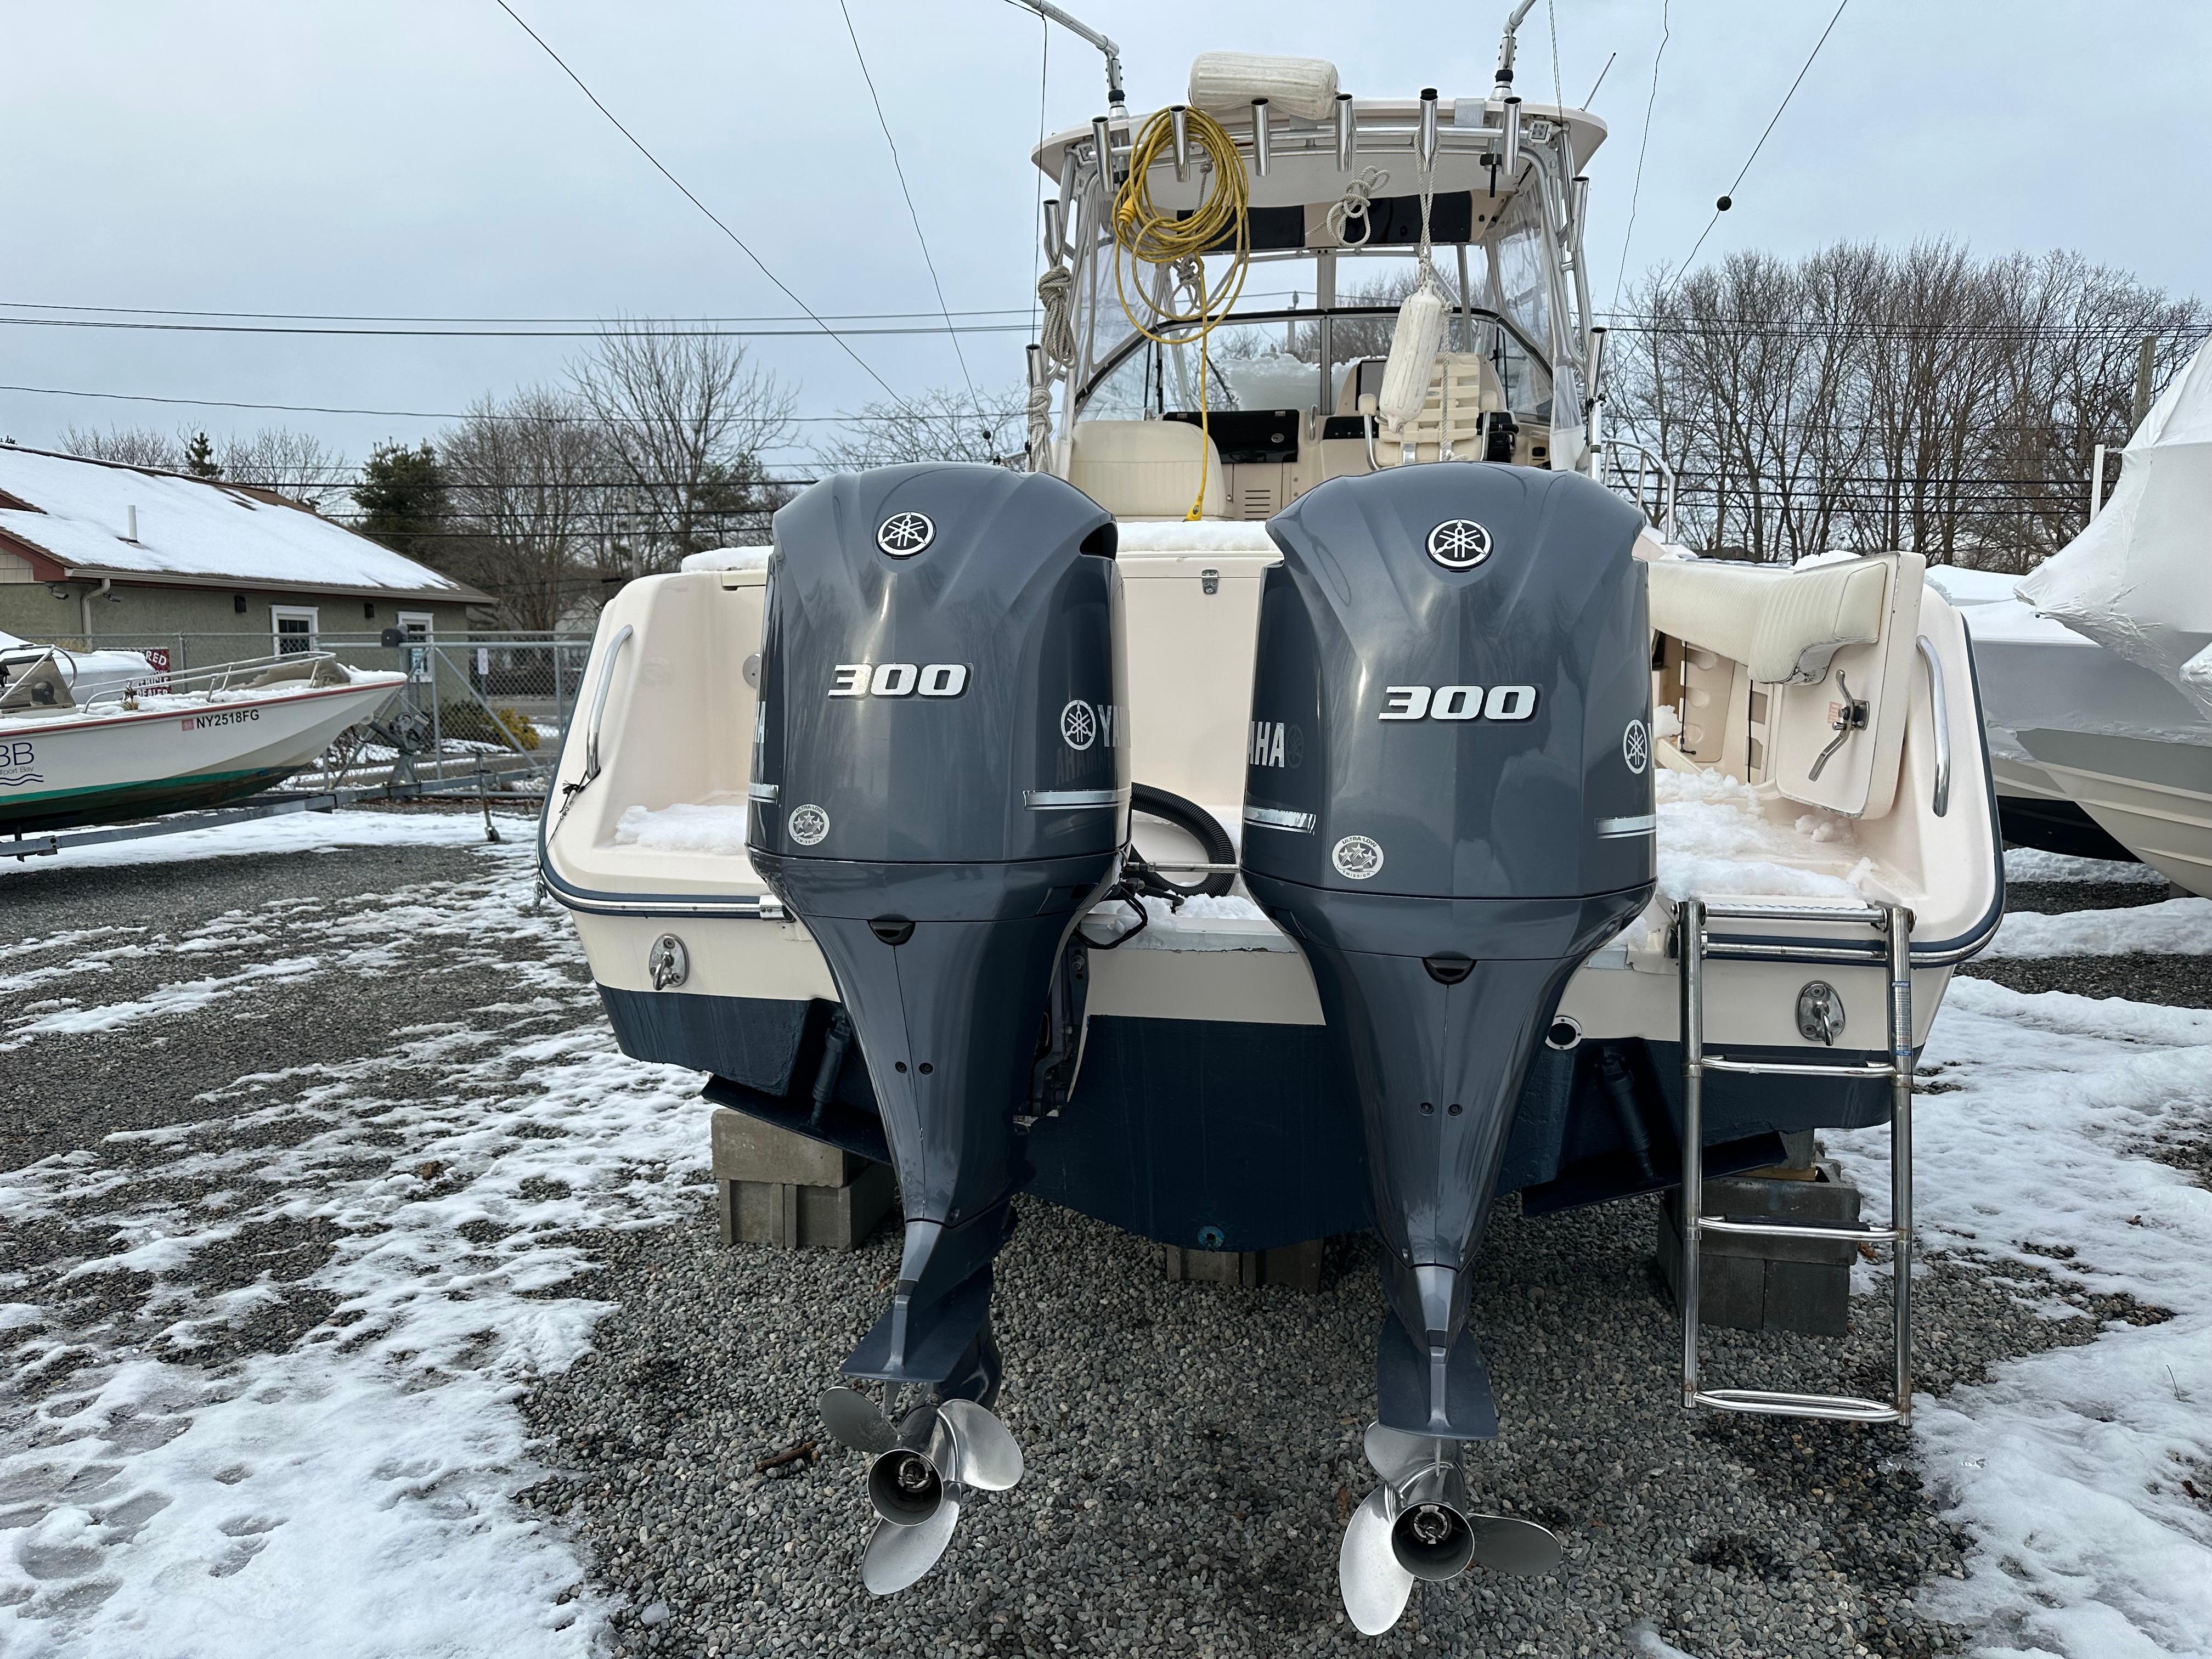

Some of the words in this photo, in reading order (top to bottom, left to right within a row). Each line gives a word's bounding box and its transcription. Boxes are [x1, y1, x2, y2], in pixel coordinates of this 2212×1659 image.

[828, 664, 967, 696] 300
[1378, 686, 1536, 719] 300
[196, 709, 259, 729] NY2518FG
[1342, 870, 1370, 878] EMISSION
